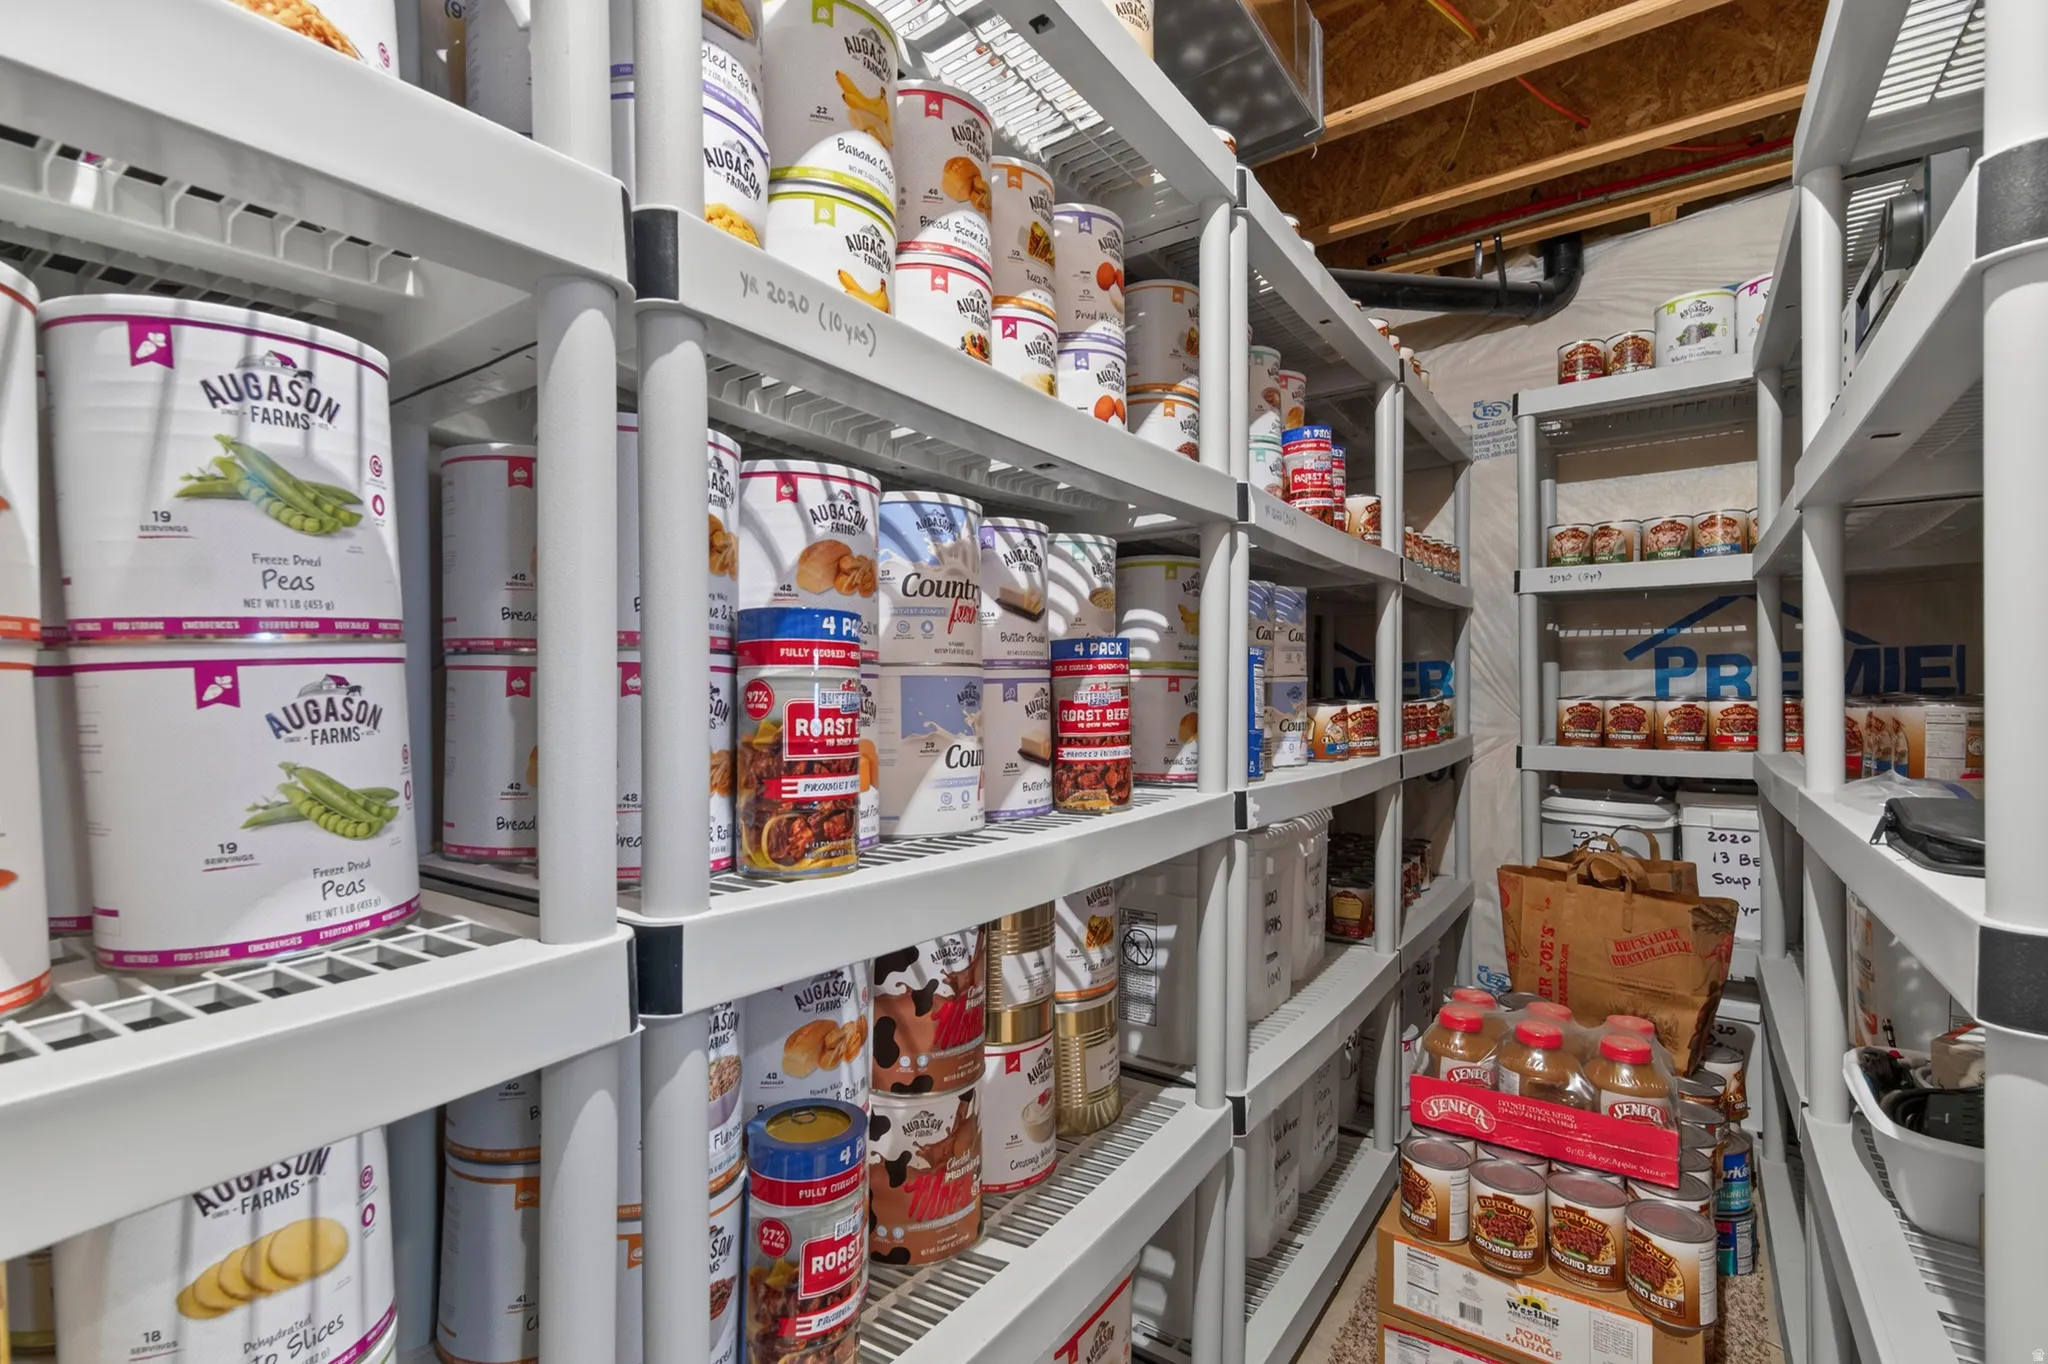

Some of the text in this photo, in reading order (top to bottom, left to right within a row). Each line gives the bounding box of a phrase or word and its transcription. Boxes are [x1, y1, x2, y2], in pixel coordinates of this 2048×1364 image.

[704, 147, 761, 200] AUGASON
[766, 281, 810, 315] 2020
[200, 373, 341, 426] AUGASON
[251, 405, 311, 430] FARMS
[152, 511, 171, 523] 19
[809, 503, 869, 533] AUGASON
[251, 553, 322, 567] Freeze Dried
[261, 568, 315, 592] Peas
[244, 599, 263, 609] NET
[266, 599, 281, 609] WT
[823, 616, 836, 635] 4
[780, 647, 810, 659] FULLY
[1090, 641, 1123, 656] PACK
[1654, 645, 1966, 698] PREIE
[265, 697, 383, 740] AUGASON
[795, 718, 854, 738] ROAST
[311, 727, 361, 746] FARMS
[945, 743, 984, 770] Coun
[496, 815, 536, 831] Bread
[1707, 831, 1752, 843] 2020
[217, 842, 238, 855] 19
[1713, 852, 1730, 864] 13
[313, 858, 371, 880] Freeze Dried
[322, 878, 366, 900] Peas
[1712, 873, 1751, 890] Soup
[306, 910, 323, 923] NET
[324, 908, 337, 920] WT
[794, 979, 854, 1012] AUGASON
[1428, 1096, 1489, 1130] SENECA
[1612, 1103, 1662, 1125] SENECA
[839, 1146, 851, 1165] 4
[241, 1180, 300, 1214] FARMS
[811, 1233, 862, 1275] ROAST
[143, 1330, 161, 1343] 18
[243, 1313, 313, 1355] Dehydrated
[287, 1313, 345, 1358] Slices
[1515, 1326, 1553, 1347] PORK
[1505, 1333, 1563, 1361] SAUSAGE
